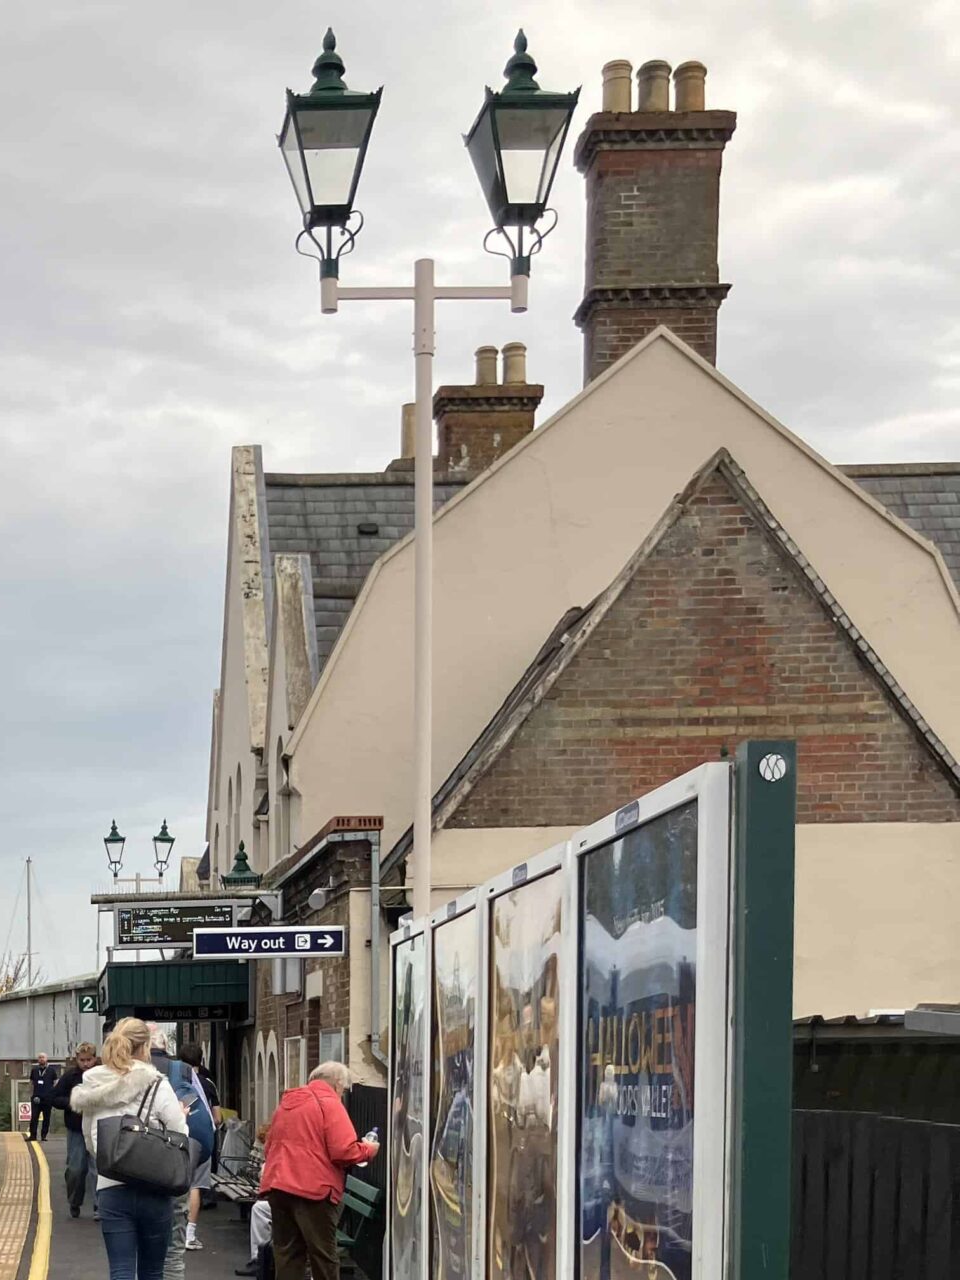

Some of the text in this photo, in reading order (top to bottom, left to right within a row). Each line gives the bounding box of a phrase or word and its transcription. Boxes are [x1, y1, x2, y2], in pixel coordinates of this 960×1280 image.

[226, 936, 285, 952] Way out
[82, 997, 94, 1012] 2
[154, 1008, 192, 1020] Way out
